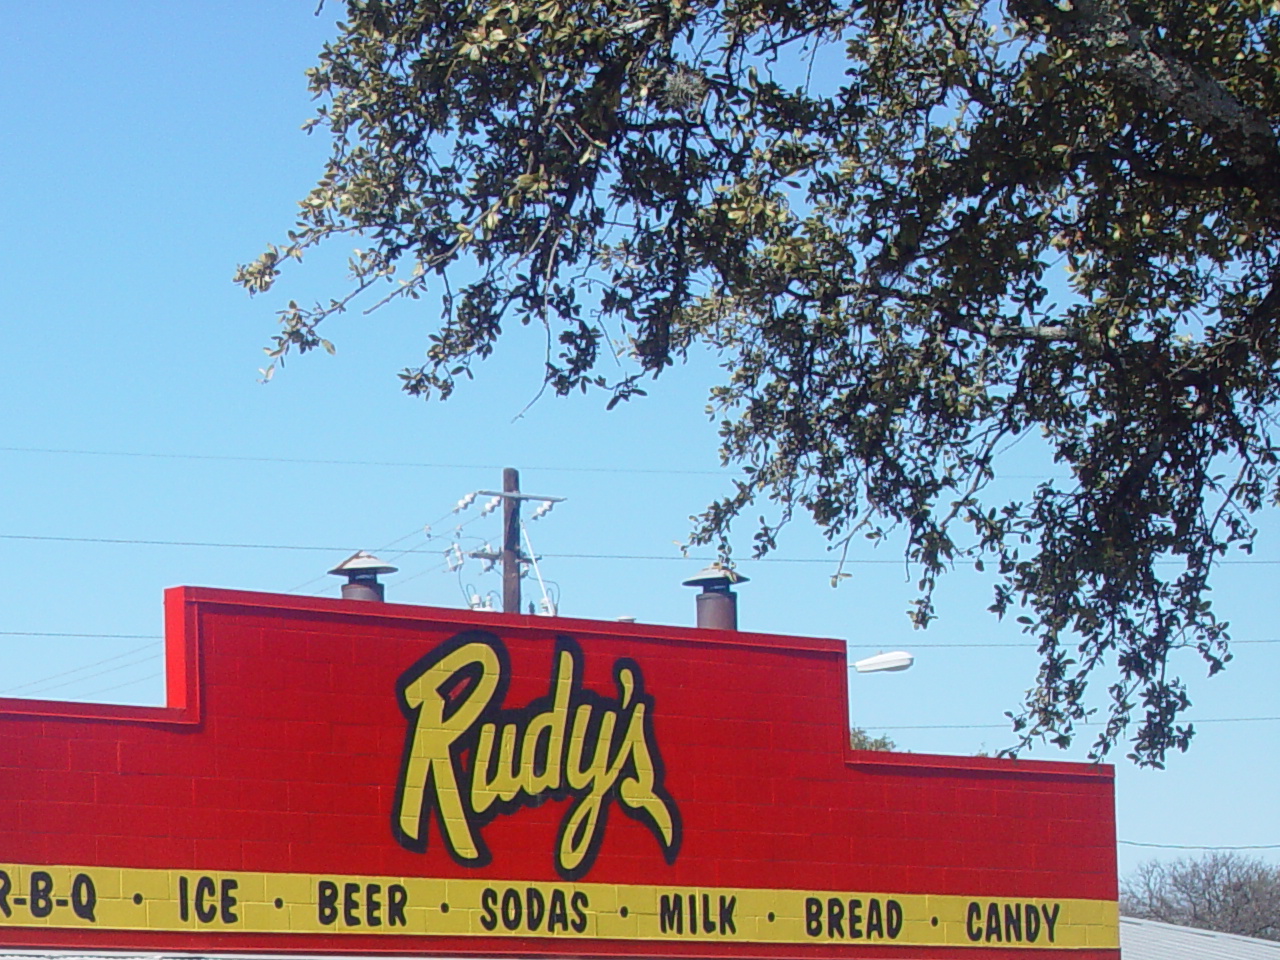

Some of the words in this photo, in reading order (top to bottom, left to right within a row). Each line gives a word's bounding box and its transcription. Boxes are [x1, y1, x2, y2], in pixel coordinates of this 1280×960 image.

[391, 631, 681, 880] Rudy's
[178, 875, 239, 924] ICE
[318, 880, 407, 927] BEER
[480, 886, 589, 933] SODAS
[659, 892, 737, 936] MILK
[805, 897, 903, 939] BREAD
[966, 902, 1061, 943] CANDY
